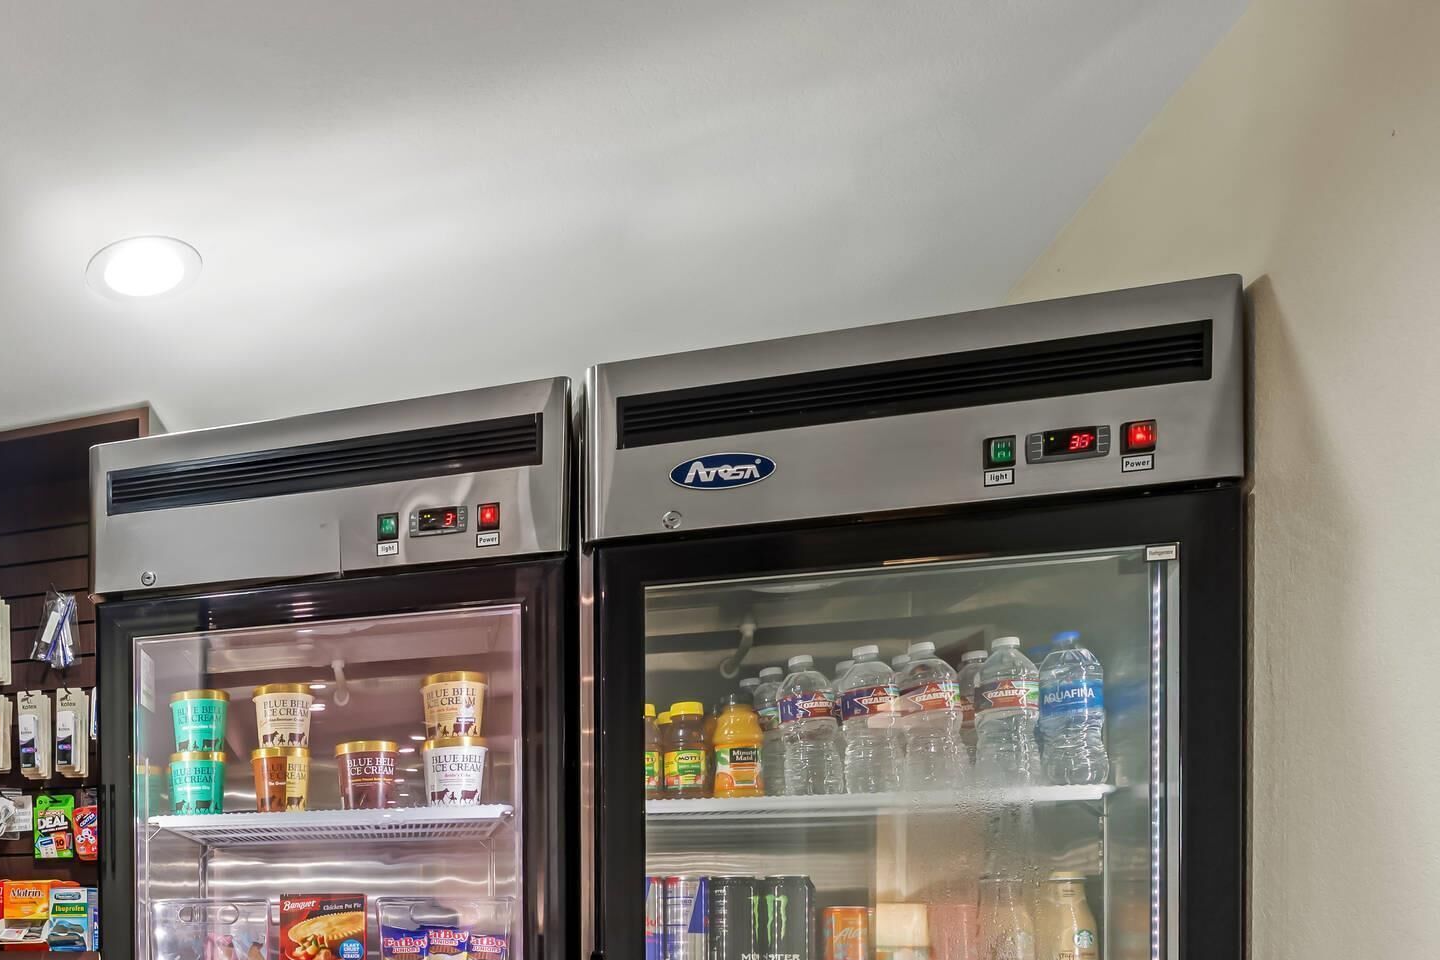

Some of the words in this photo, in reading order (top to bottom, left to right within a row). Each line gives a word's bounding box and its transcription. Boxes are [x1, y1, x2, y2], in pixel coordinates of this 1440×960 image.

[1124, 459, 1151, 468] Power
[990, 473, 1008, 482] light
[478, 536, 497, 544] Power
[381, 544, 395, 553] light
[985, 689, 1028, 700] OZARKA
[1043, 687, 1096, 705] AQUAFINA
[803, 700, 834, 710] OZARKA
[279, 708, 309, 718] CREAM
[731, 748, 757, 758] Minute
[734, 754, 754, 762] Maid
[347, 757, 373, 768] BLUE
[375, 756, 395, 767] BELL
[431, 754, 457, 764] BLUE
[461, 754, 482, 764] BELL
[348, 767, 363, 777] ICE
[364, 766, 394, 776] CREAM
[432, 763, 447, 773] ICE
[454, 763, 482, 773] CREAM
[36, 818, 69, 832] DEAL
[10, 888, 41, 899] Motrin
[55, 904, 85, 914] Ibuprofen
[282, 900, 317, 912] Banquet
[383, 937, 428, 949] FatBoy
